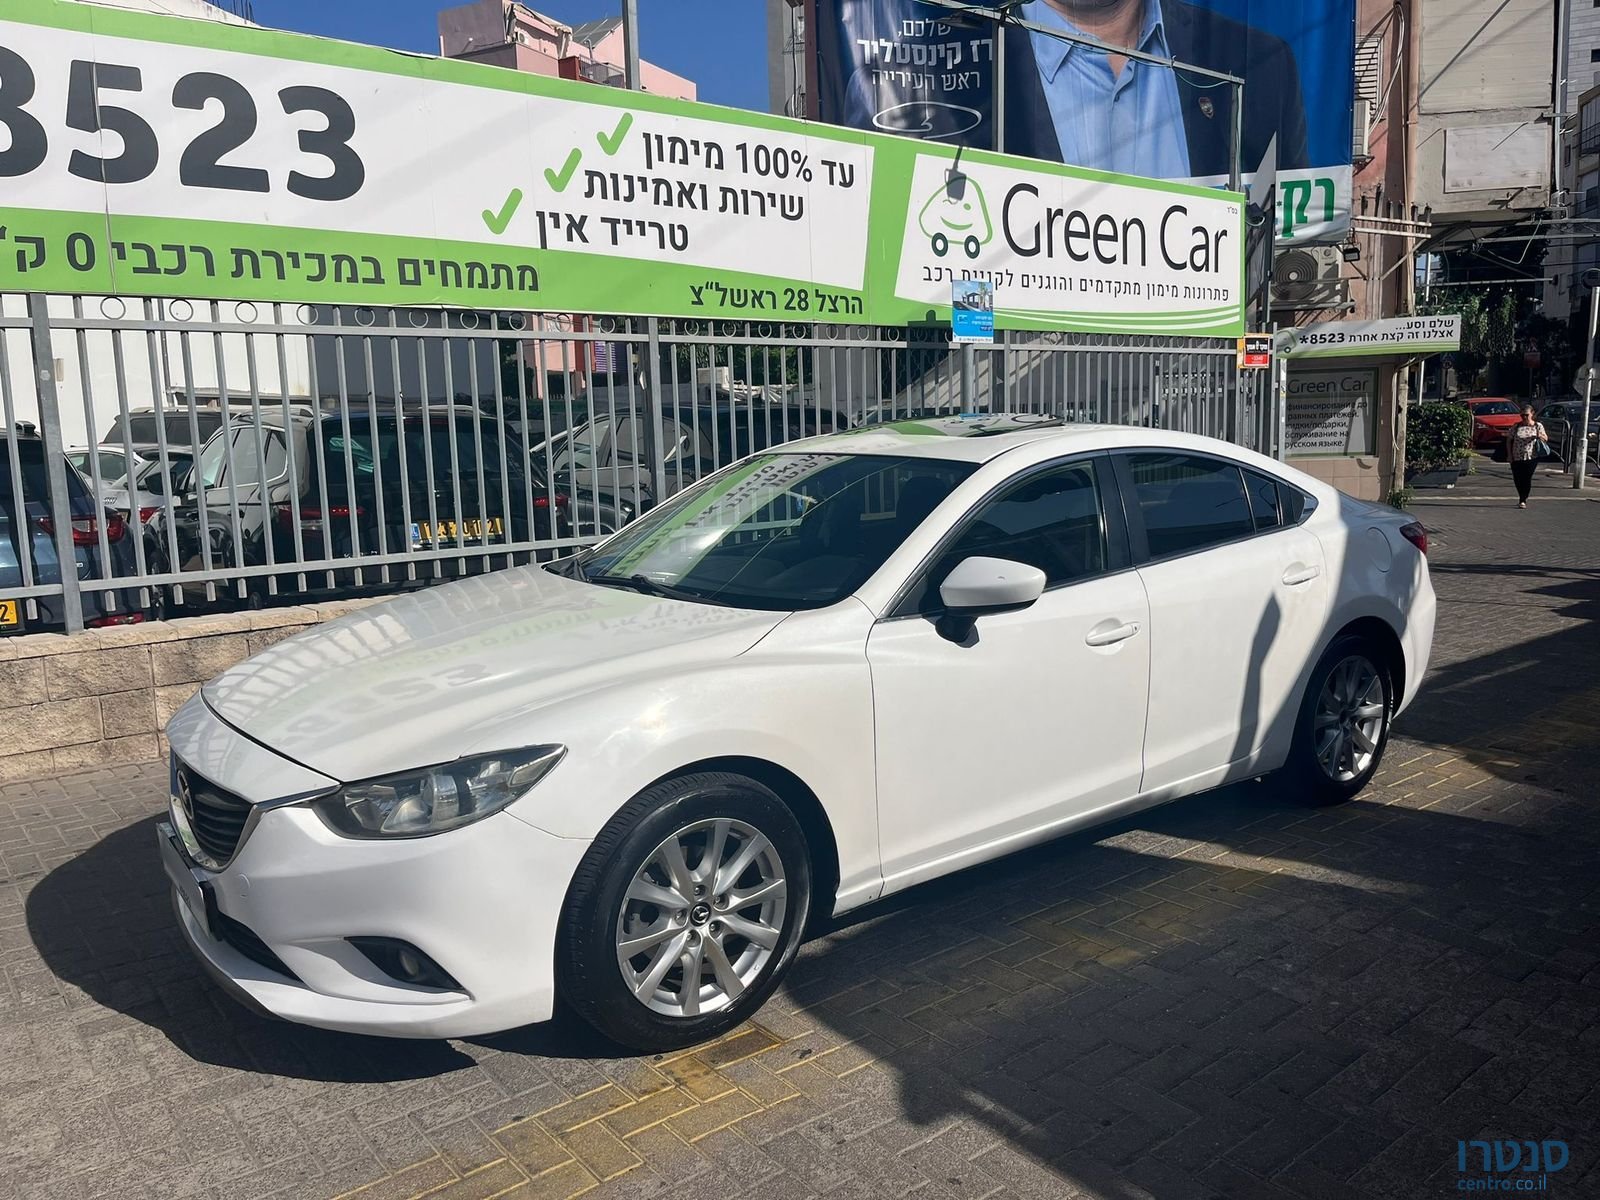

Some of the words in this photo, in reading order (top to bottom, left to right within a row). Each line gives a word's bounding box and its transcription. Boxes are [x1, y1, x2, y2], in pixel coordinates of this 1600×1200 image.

[898, 18, 951, 37] שלכם,
[970, 39, 992, 63] רז
[872, 69, 935, 90] העירייה
[941, 71, 981, 91] ראש
[642, 131, 724, 170] מימון
[735, 142, 813, 182] 100%
[820, 159, 855, 189] עד
[583, 169, 707, 211] ואמינות
[718, 185, 804, 221] שירות
[535, 209, 590, 250] אין
[601, 216, 689, 251] טרייד
[1002, 183, 1147, 267] Green
[1159, 205, 1228, 273] Car
[66, 232, 96, 272] 0
[111, 241, 216, 277] רכבי
[230, 247, 386, 285] במכירת
[399, 258, 539, 291] מתמחים
[922, 266, 954, 283] רכב
[1021, 275, 1074, 291] והוגנים
[1079, 278, 1141, 297] מתקדמים
[1146, 281, 1180, 300] מימון
[1183, 286, 1230, 301] פתרונות
[783, 288, 809, 311] 28
[816, 289, 864, 315] הרצל
[1423, 329, 1454, 338] אצלנו
[1429, 318, 1454, 328] שלם
[1348, 333, 1378, 343] אחרת
[1381, 332, 1404, 343] קצת
[1407, 331, 1420, 339] זה
[1287, 379, 1337, 394] Green
[1341, 377, 1368, 392] Car
